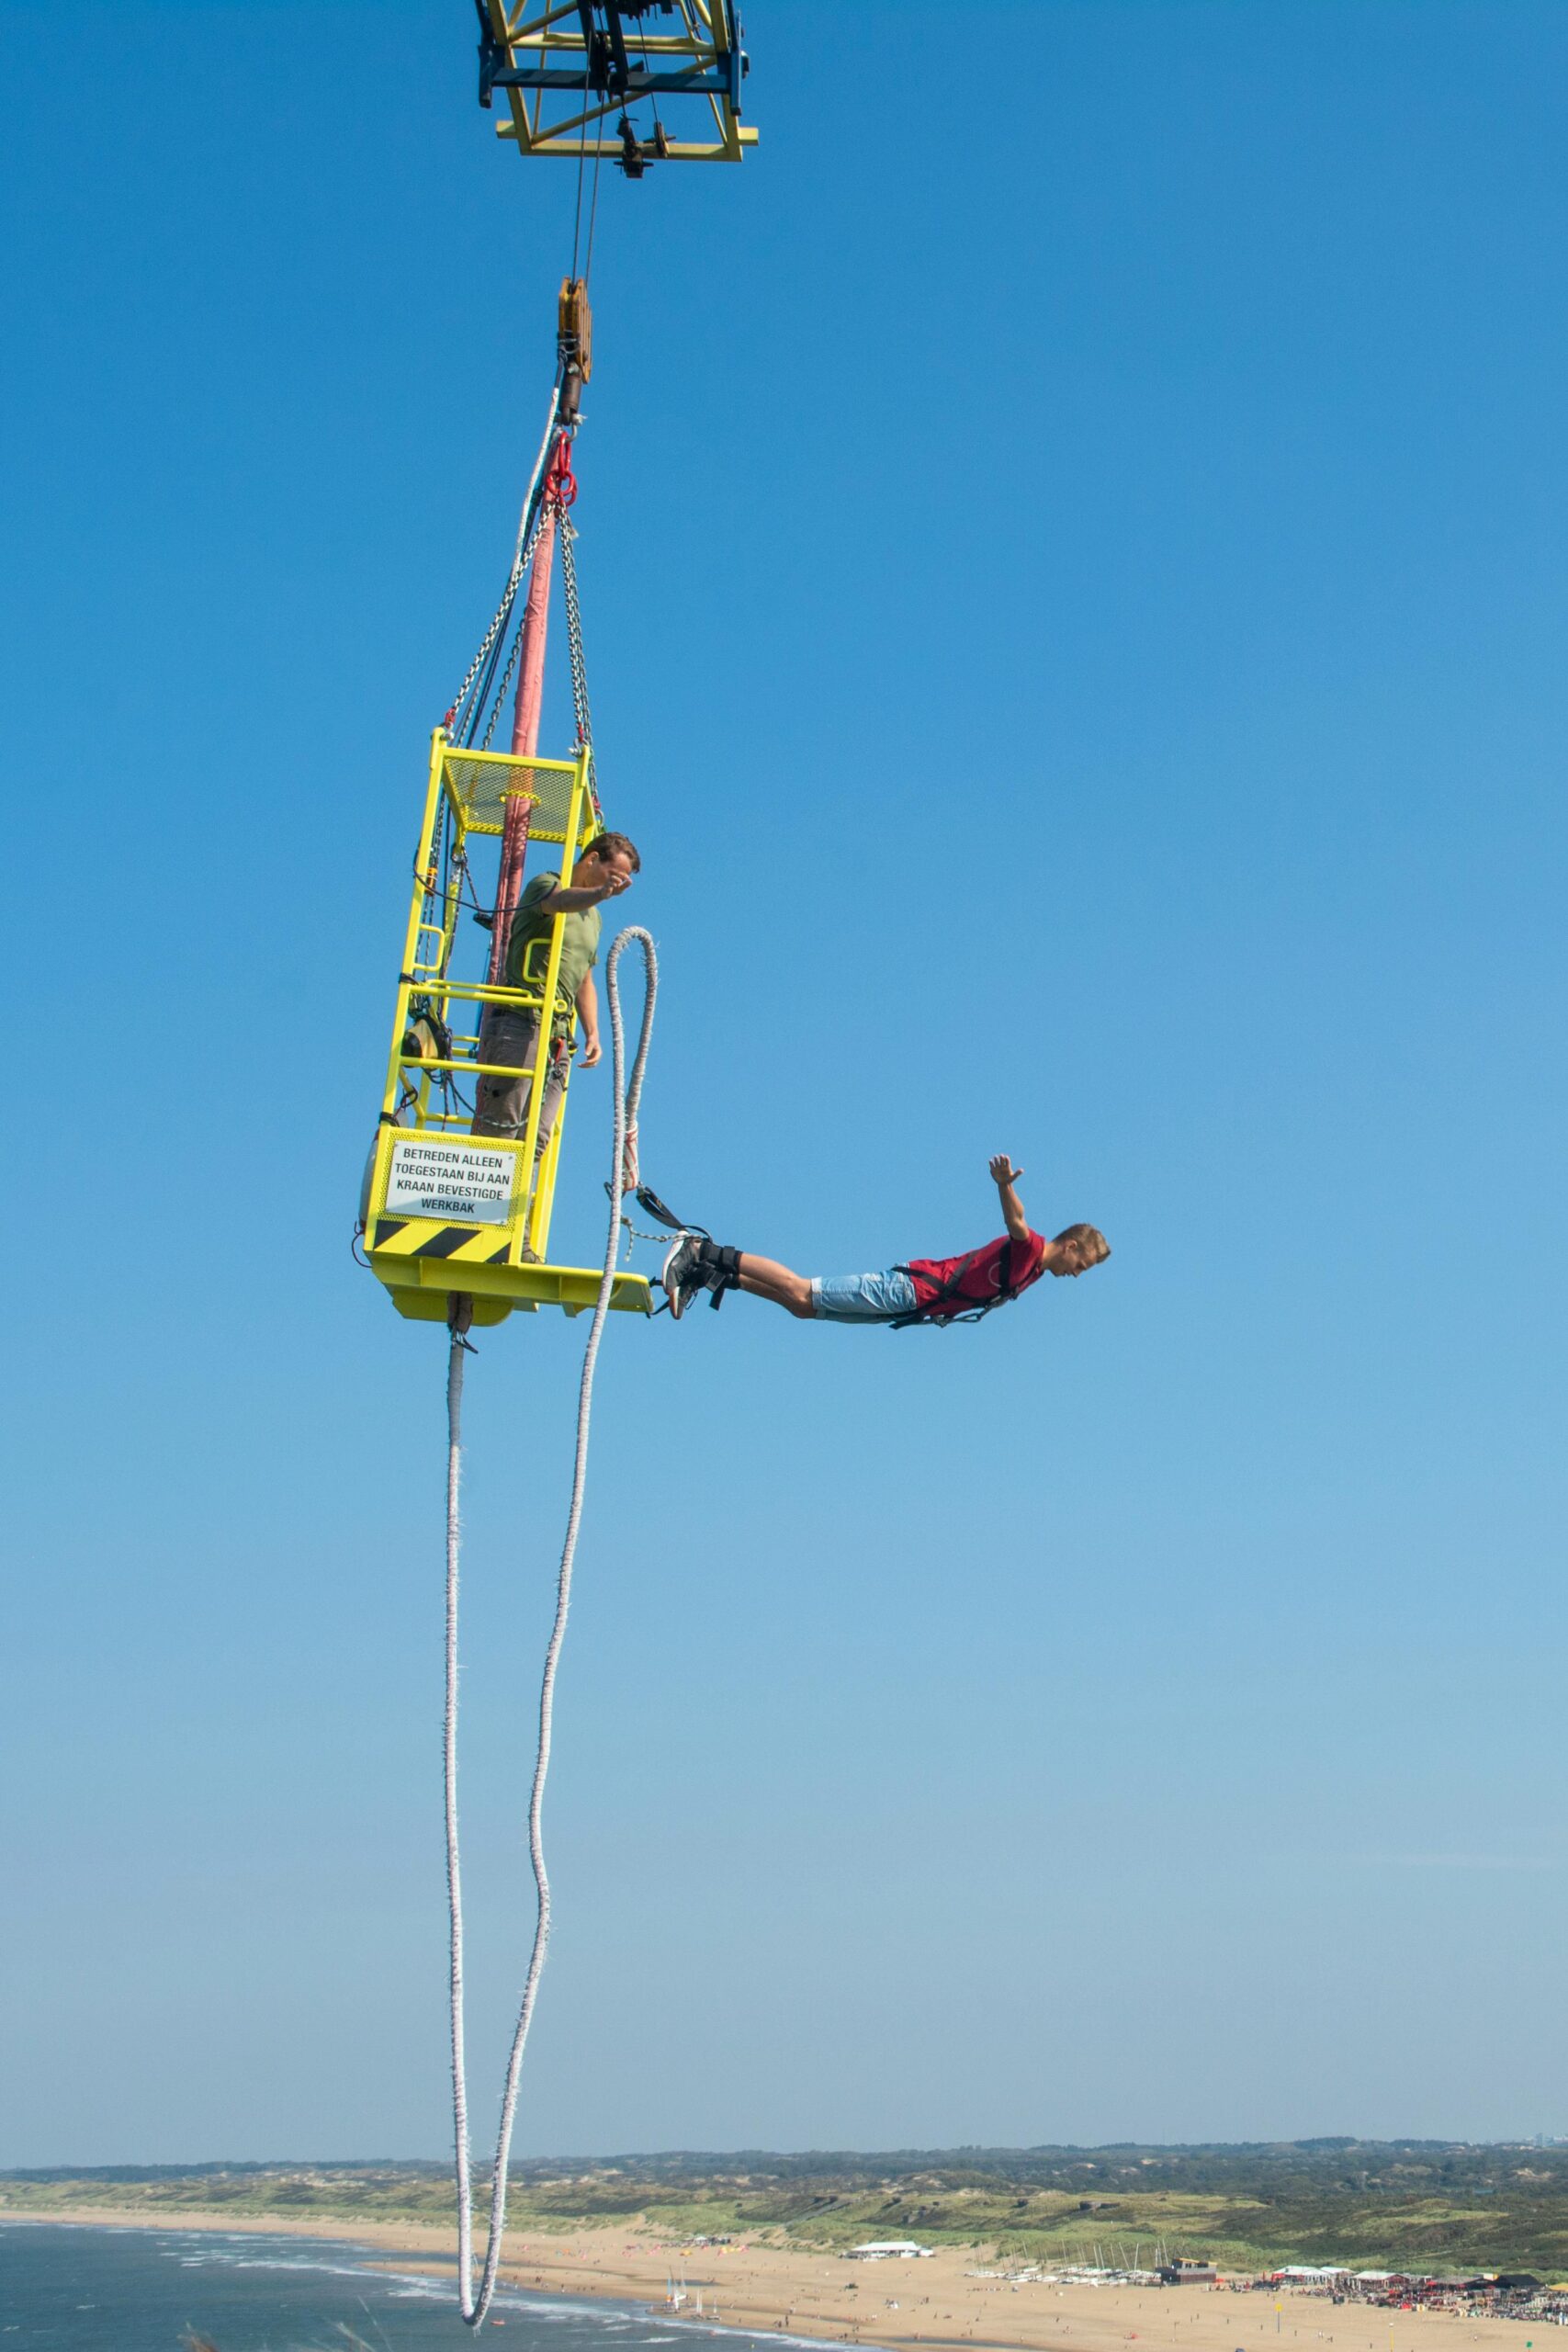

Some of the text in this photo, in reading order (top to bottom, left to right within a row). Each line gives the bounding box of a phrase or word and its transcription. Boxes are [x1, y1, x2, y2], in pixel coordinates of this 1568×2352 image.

[403, 1148, 502, 1168] BETREDEN ALLEEN
[395, 1163, 510, 1185] TOEGESTAAN BIJ AAN
[397, 1179, 504, 1201] KRAAN BEVESTIGDE
[421, 1198, 475, 1214] WERKBAK
